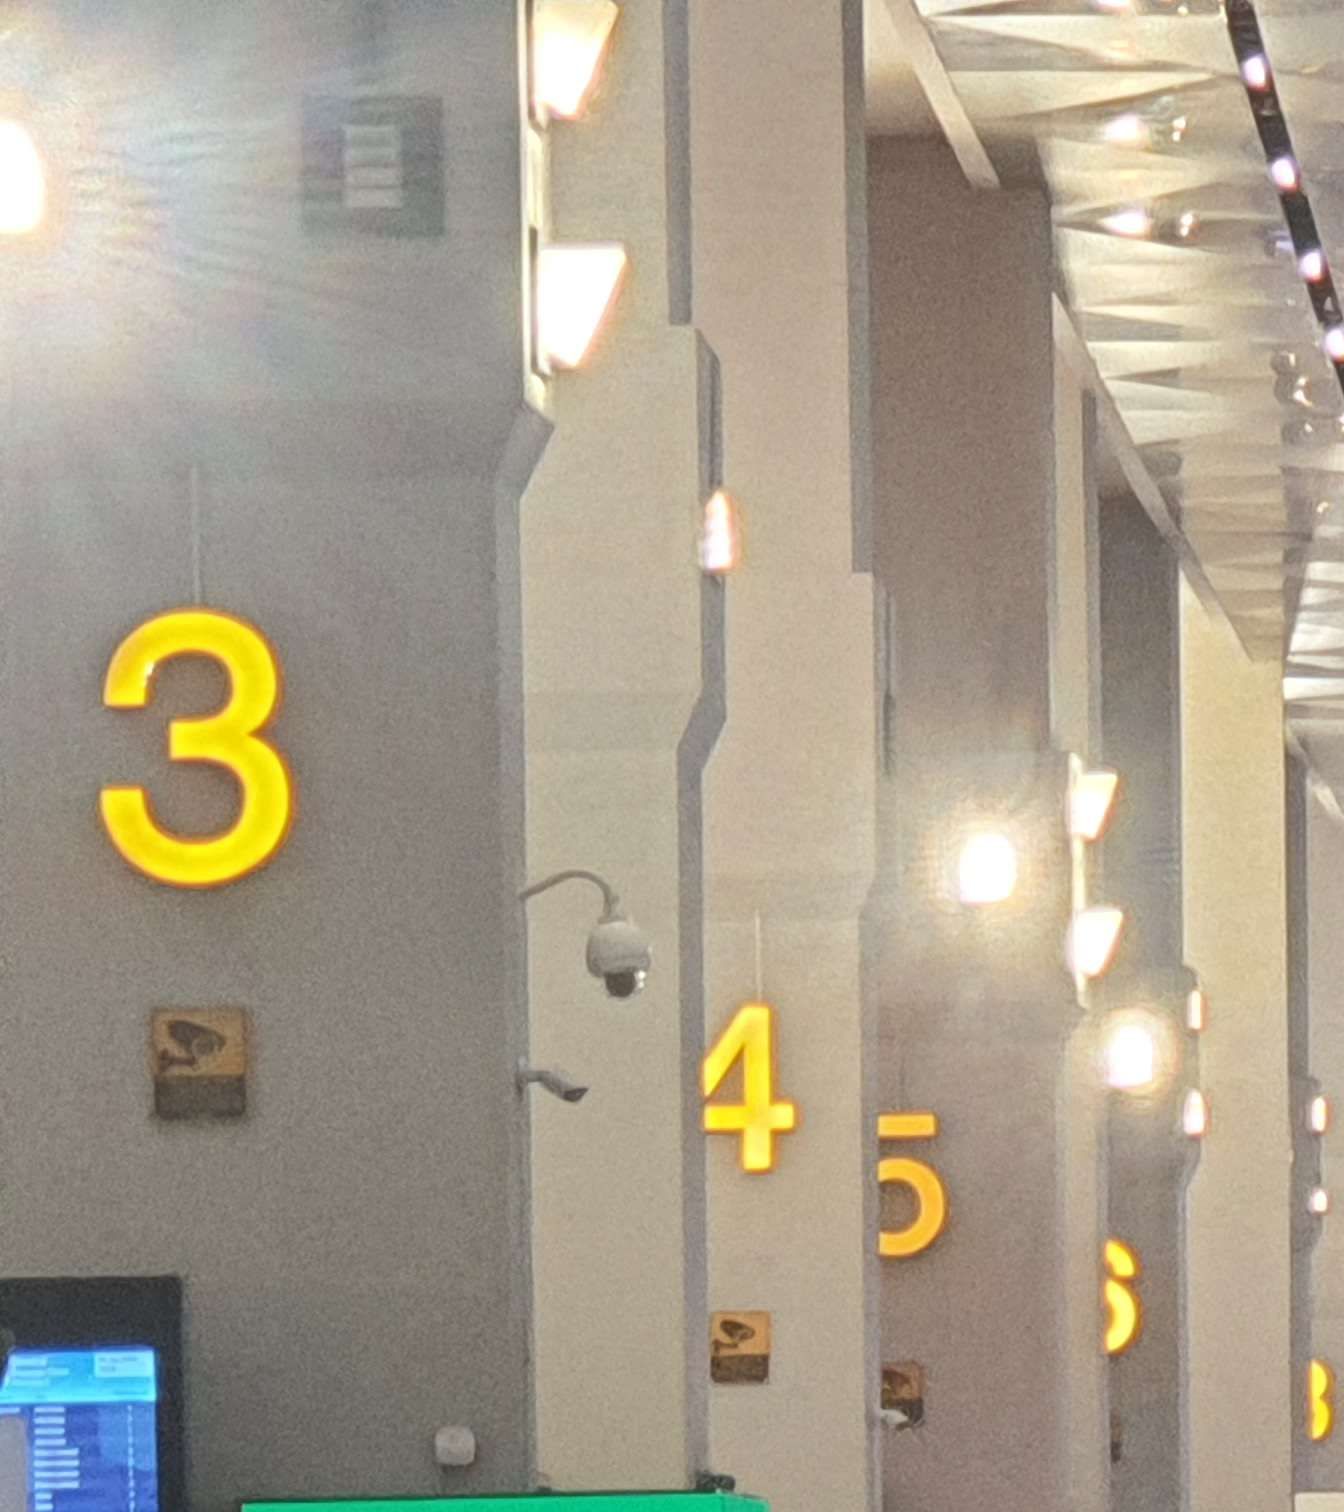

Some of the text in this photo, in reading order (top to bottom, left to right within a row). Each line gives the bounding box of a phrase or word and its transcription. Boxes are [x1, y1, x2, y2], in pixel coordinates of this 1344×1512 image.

[99, 608, 294, 886] 3
[703, 1003, 797, 1173] 4
[878, 1113, 949, 1258] 5
